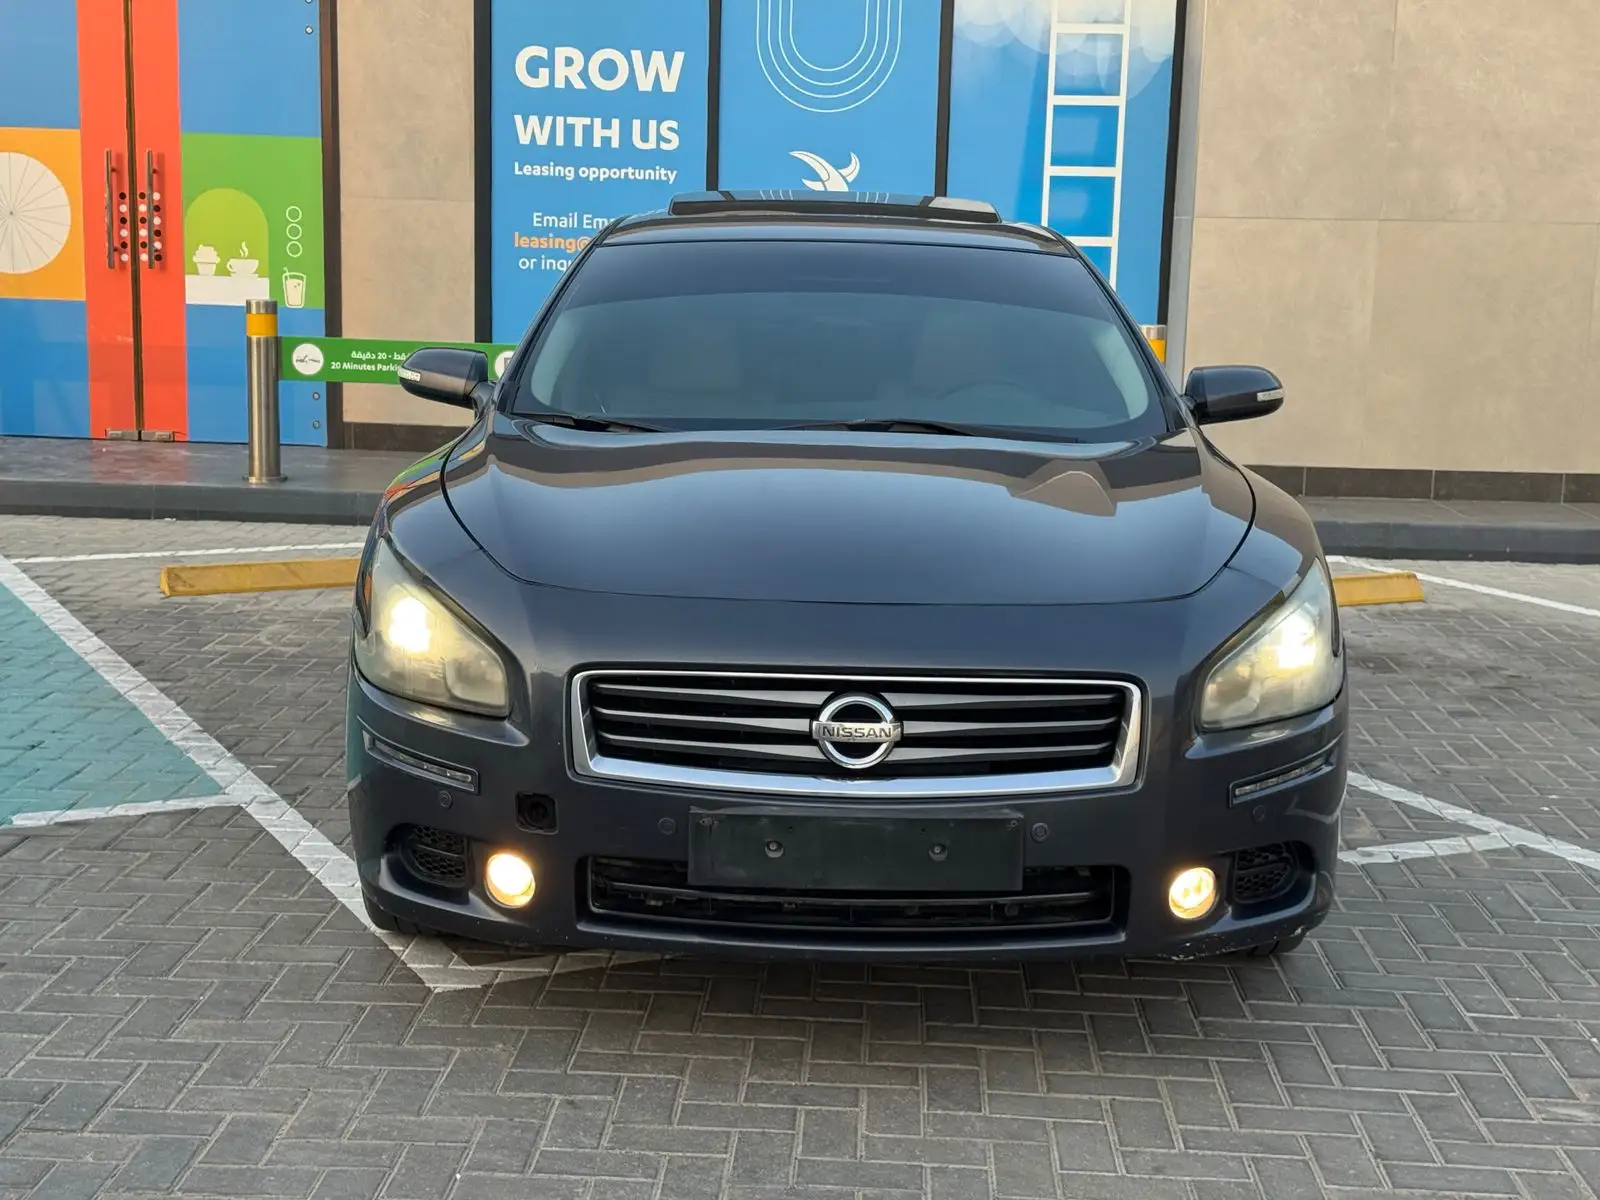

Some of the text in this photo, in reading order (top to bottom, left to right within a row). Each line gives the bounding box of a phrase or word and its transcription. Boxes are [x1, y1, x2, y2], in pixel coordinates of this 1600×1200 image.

[515, 45, 685, 93] GROW
[514, 114, 680, 151] WITH US
[514, 161, 678, 184] Leasing opportunity
[532, 212, 578, 228] Email
[518, 257, 537, 270] or
[377, 352, 387, 360] 20
[330, 362, 341, 370] 20
[342, 362, 375, 371] Minutes
[822, 725, 892, 739] NISSAN
